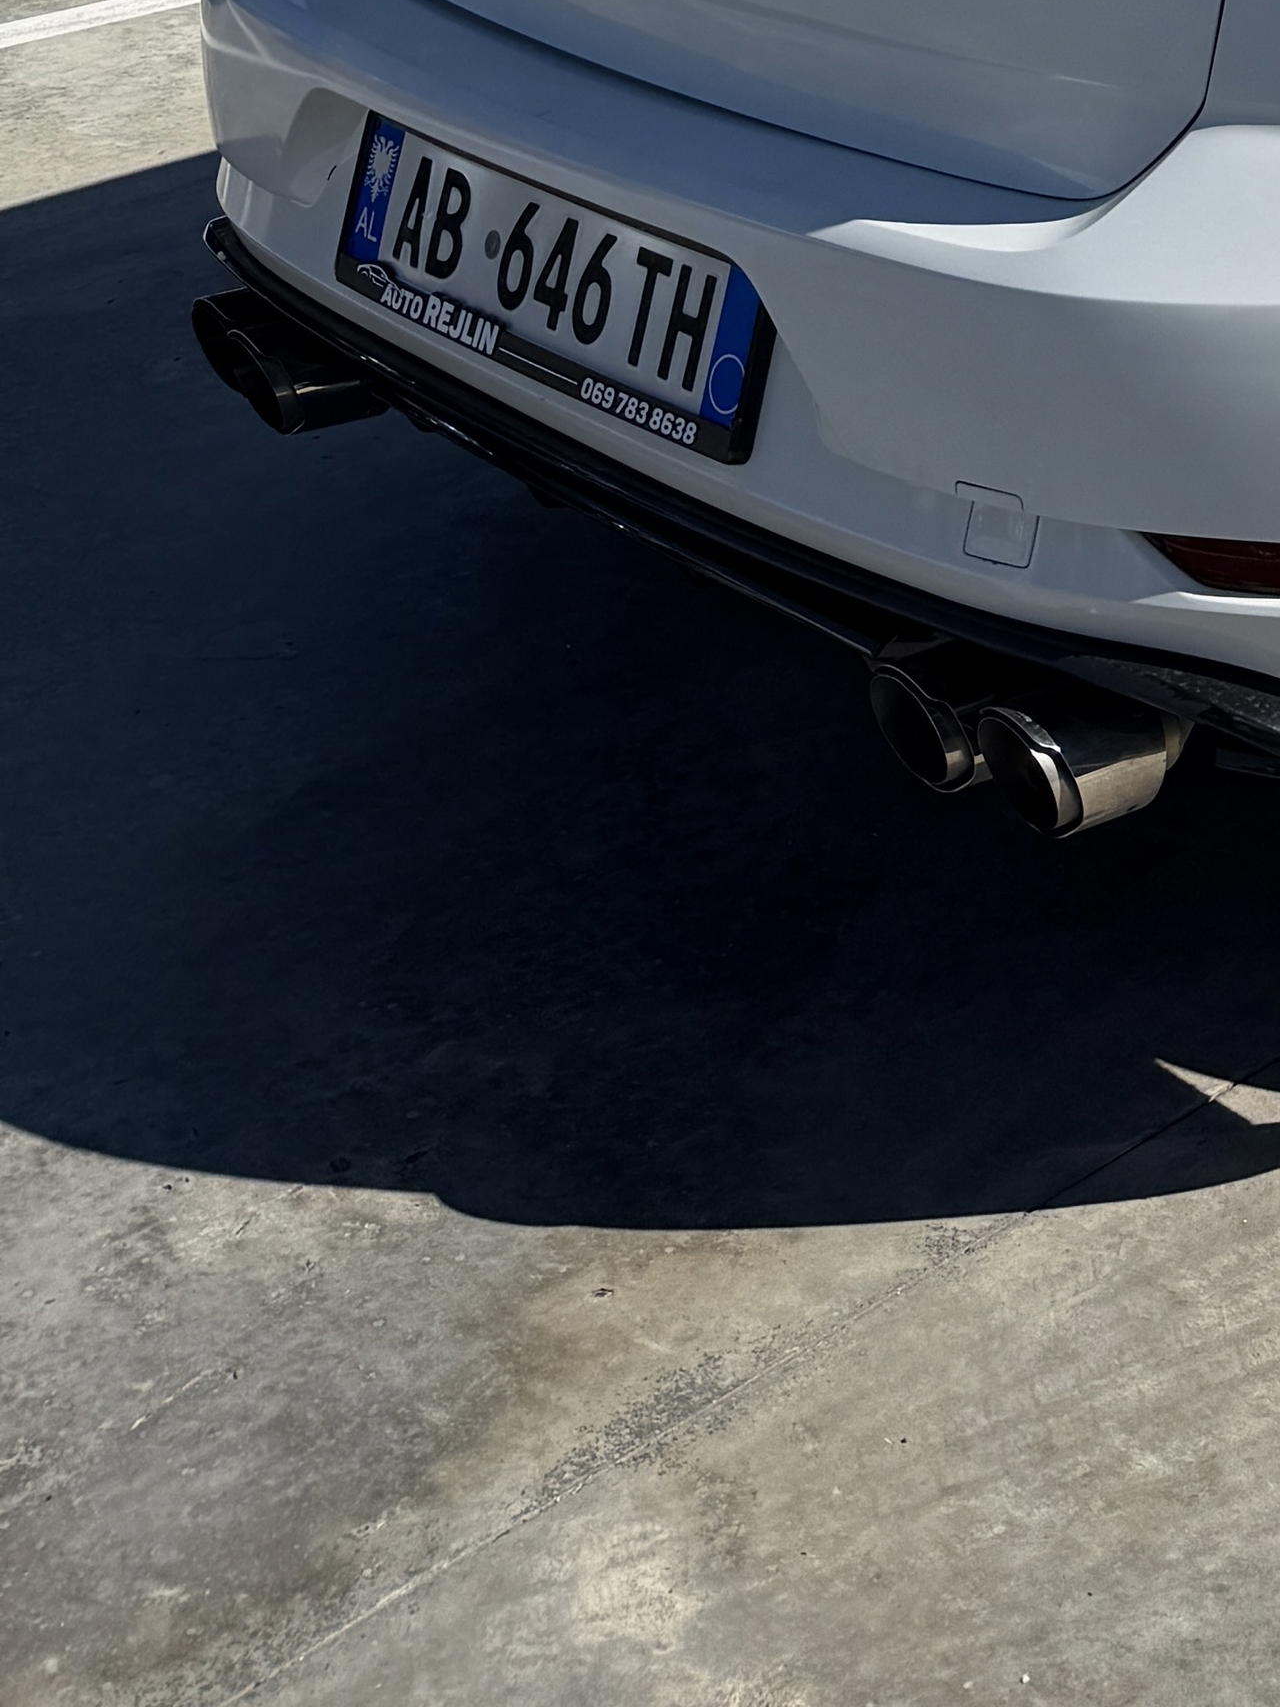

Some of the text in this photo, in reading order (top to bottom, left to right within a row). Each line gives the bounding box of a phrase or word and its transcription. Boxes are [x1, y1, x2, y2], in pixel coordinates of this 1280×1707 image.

[355, 205, 378, 243] AL
[392, 156, 717, 392] AB 646 TH
[380, 282, 500, 357] AUTO REJLIN
[580, 375, 698, 445] 069 783 8638
